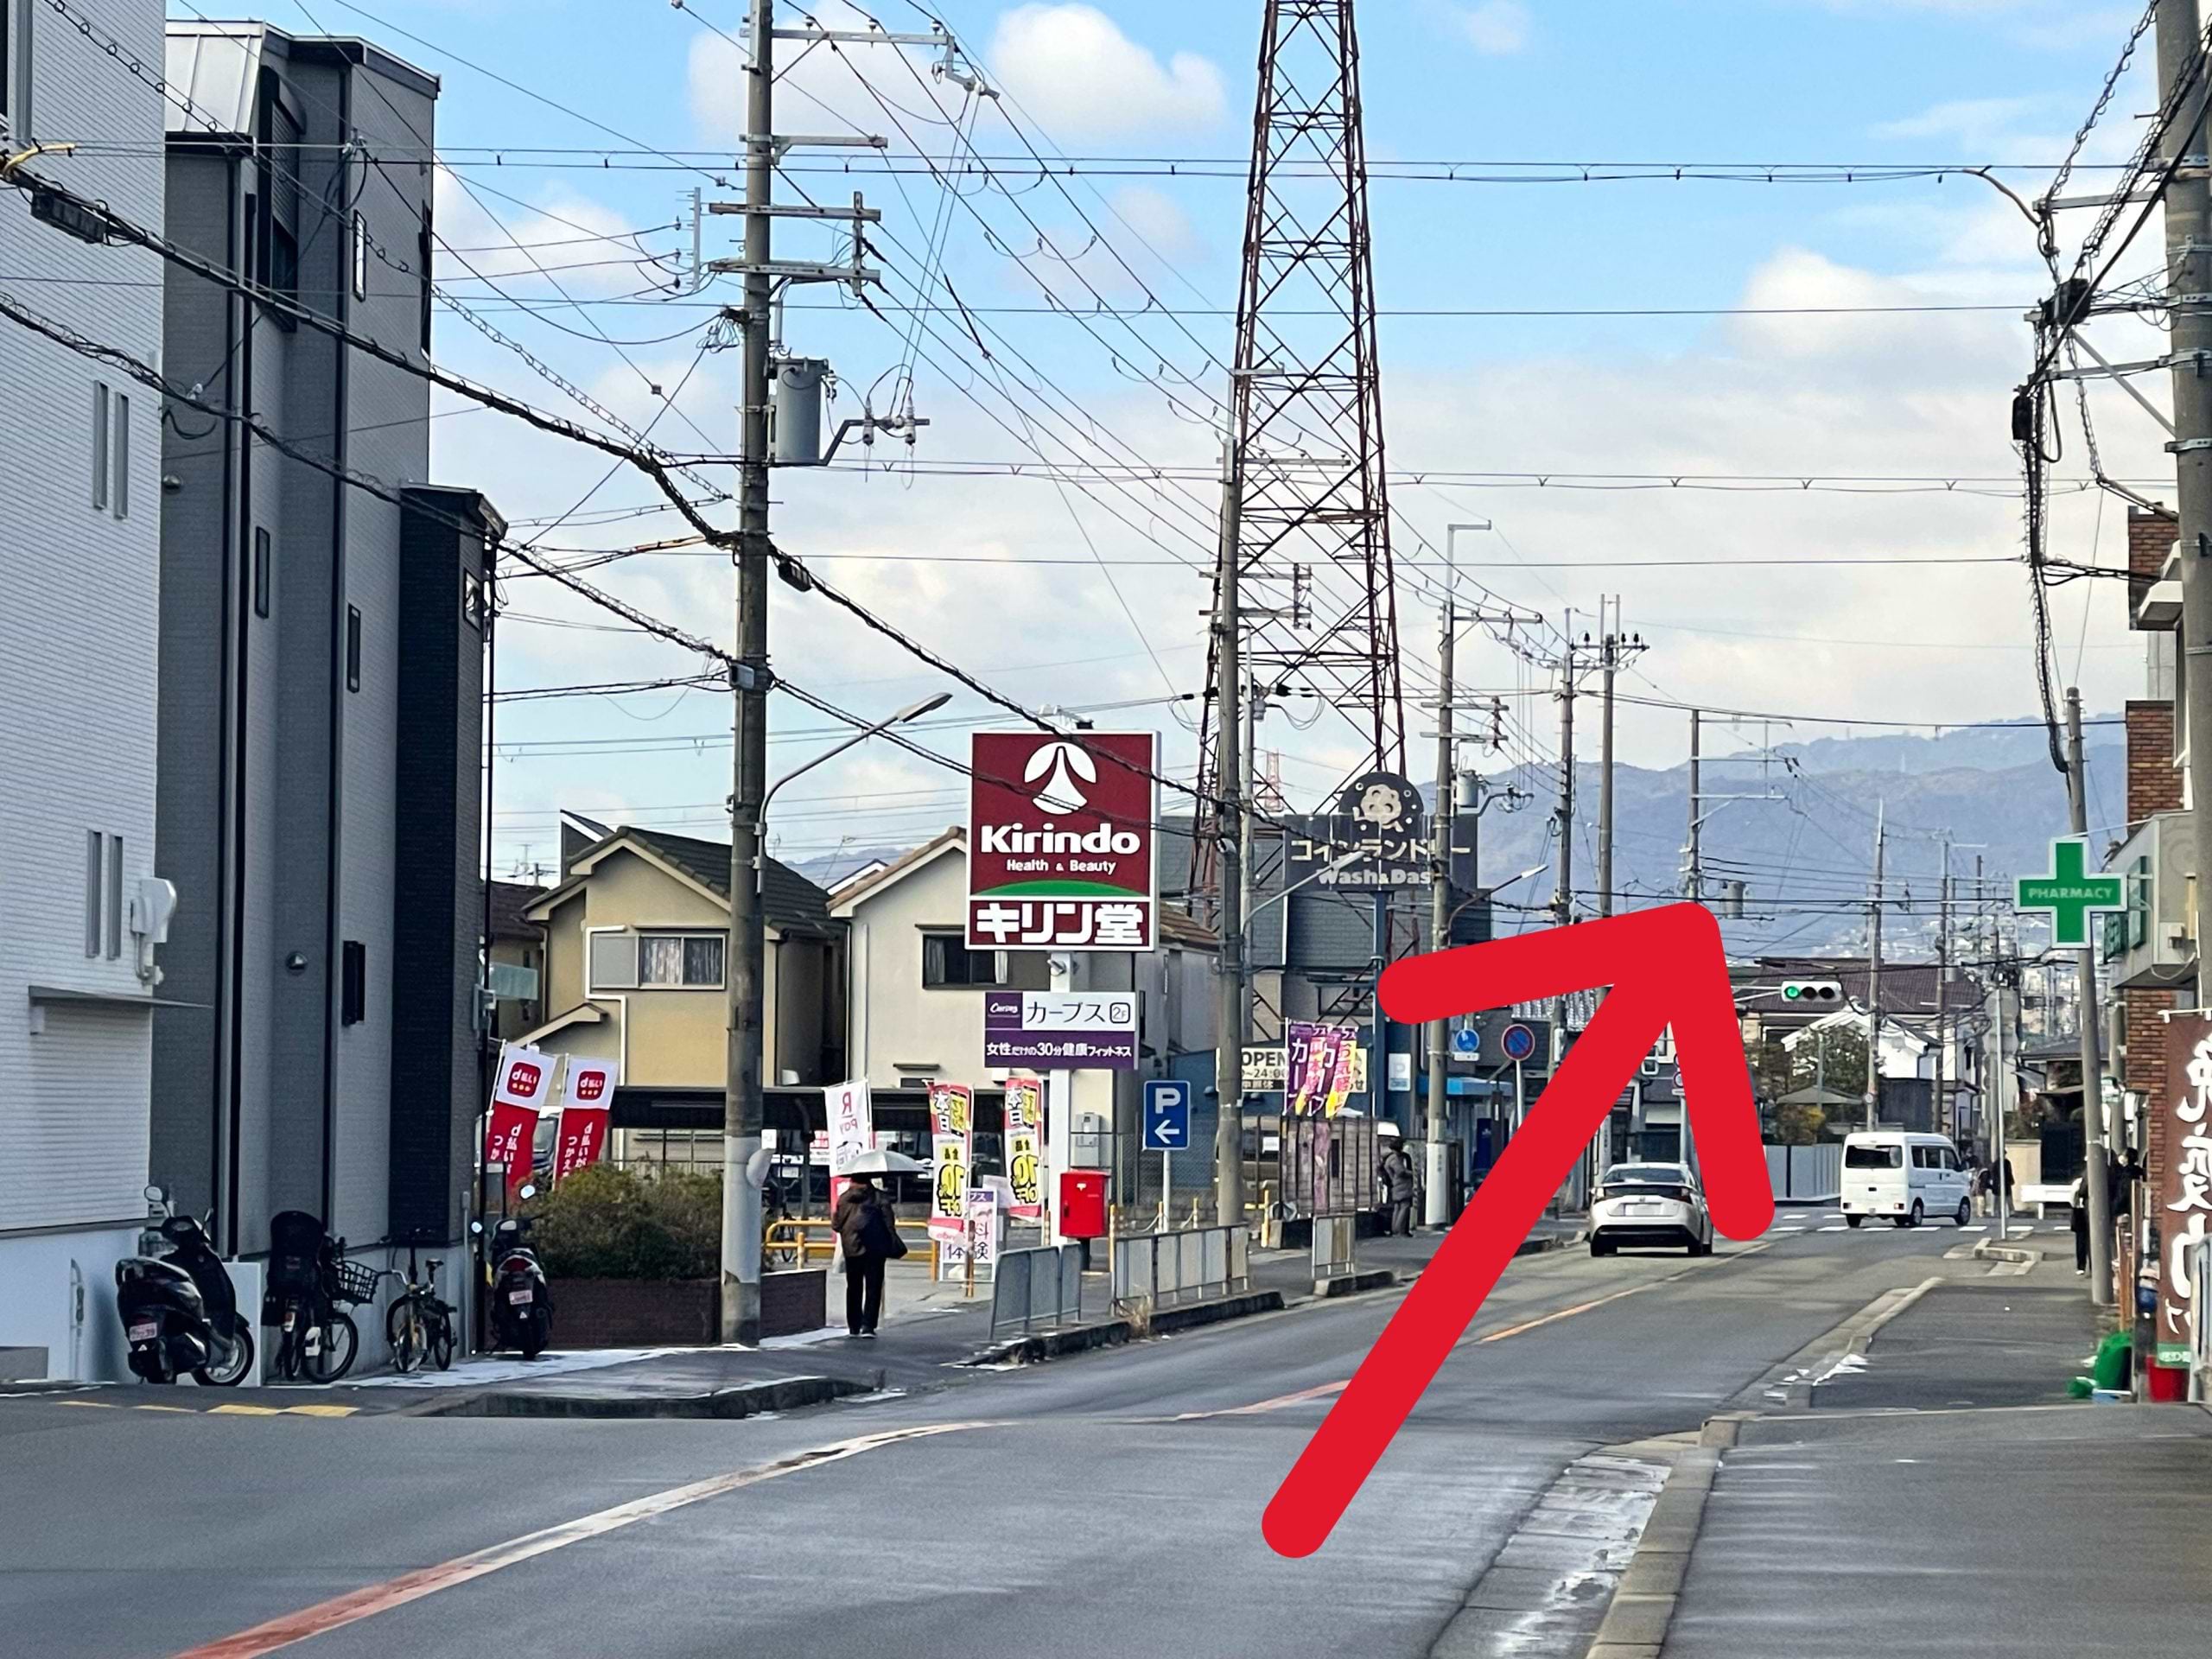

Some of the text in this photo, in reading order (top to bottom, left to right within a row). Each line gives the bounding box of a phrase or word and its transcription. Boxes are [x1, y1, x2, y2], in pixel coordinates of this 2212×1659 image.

[981, 823, 1141, 854] Kirindo
[1007, 860, 1116, 875] Health & Beauty
[2028, 887, 2113, 899] PHARMACY
[976, 903, 1143, 944] キリン堂
[1026, 1001, 1106, 1024] カーブス
[1155, 1088, 1180, 1114] P
